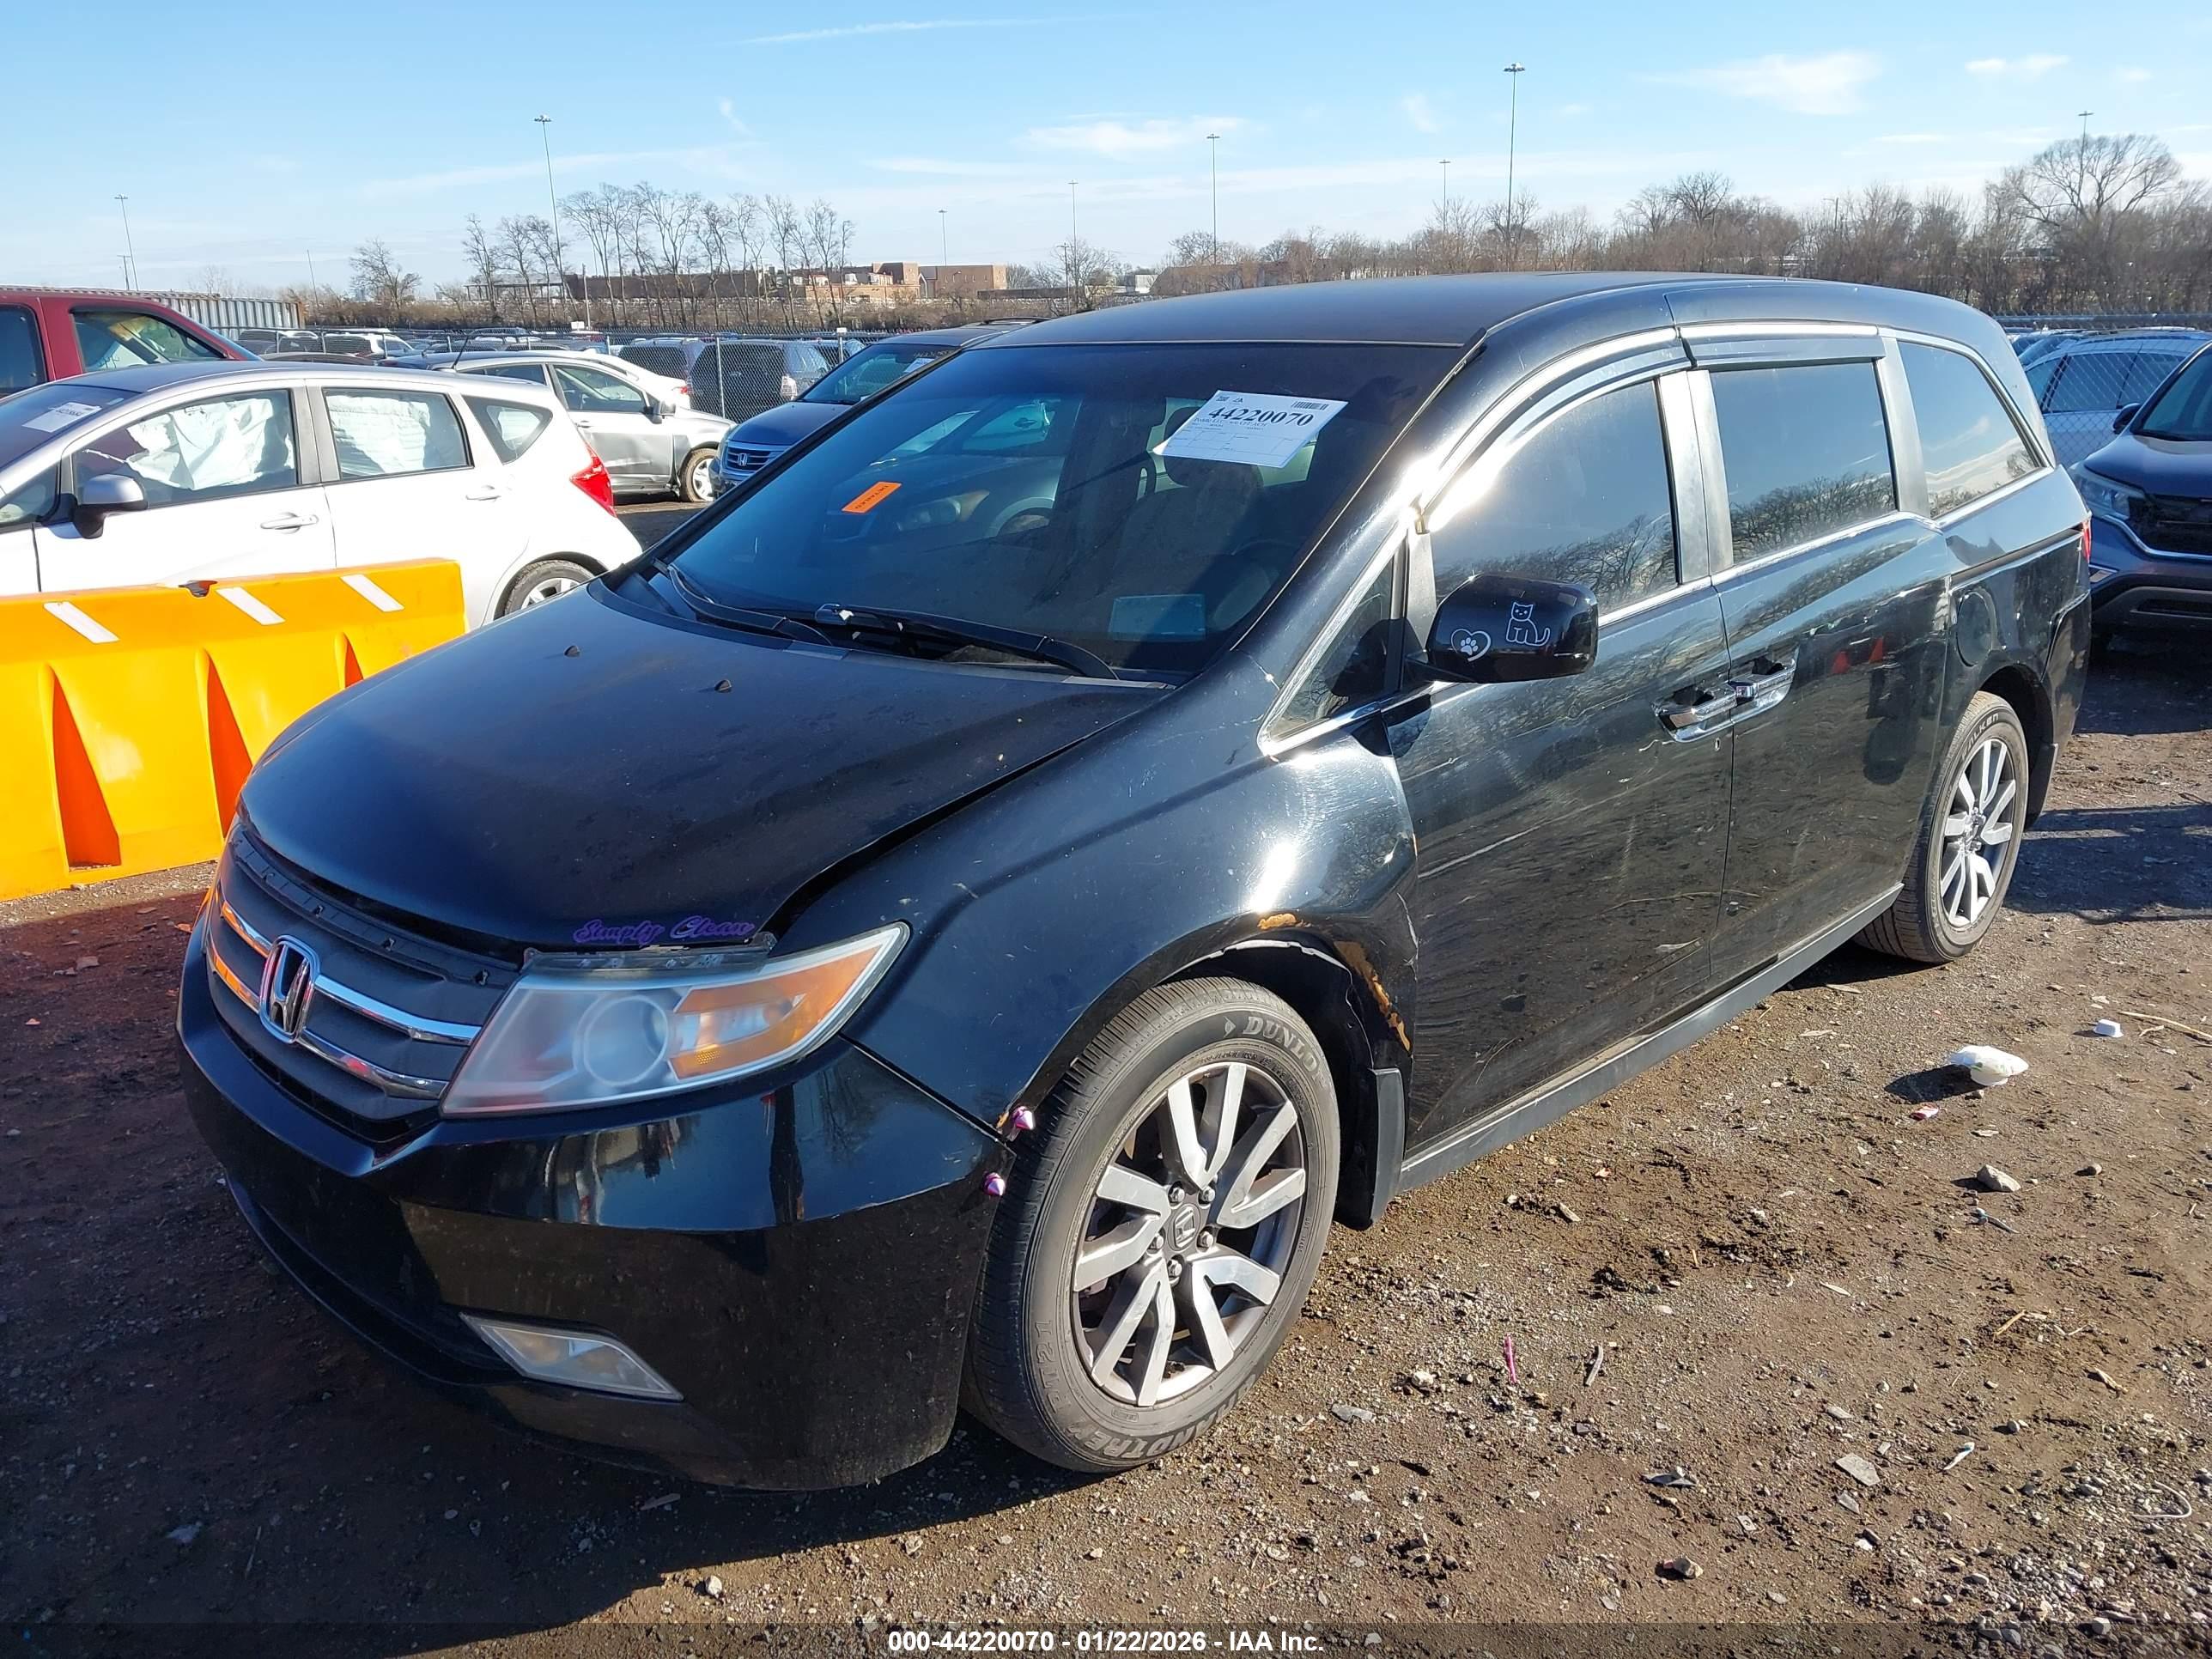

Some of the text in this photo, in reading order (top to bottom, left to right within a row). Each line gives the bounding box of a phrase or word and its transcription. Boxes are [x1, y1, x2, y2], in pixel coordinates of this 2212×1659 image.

[1209, 406, 1314, 426] 44220070
[573, 915, 755, 948] Simply Clean
[1243, 1016, 1327, 1089] DUNLOP
